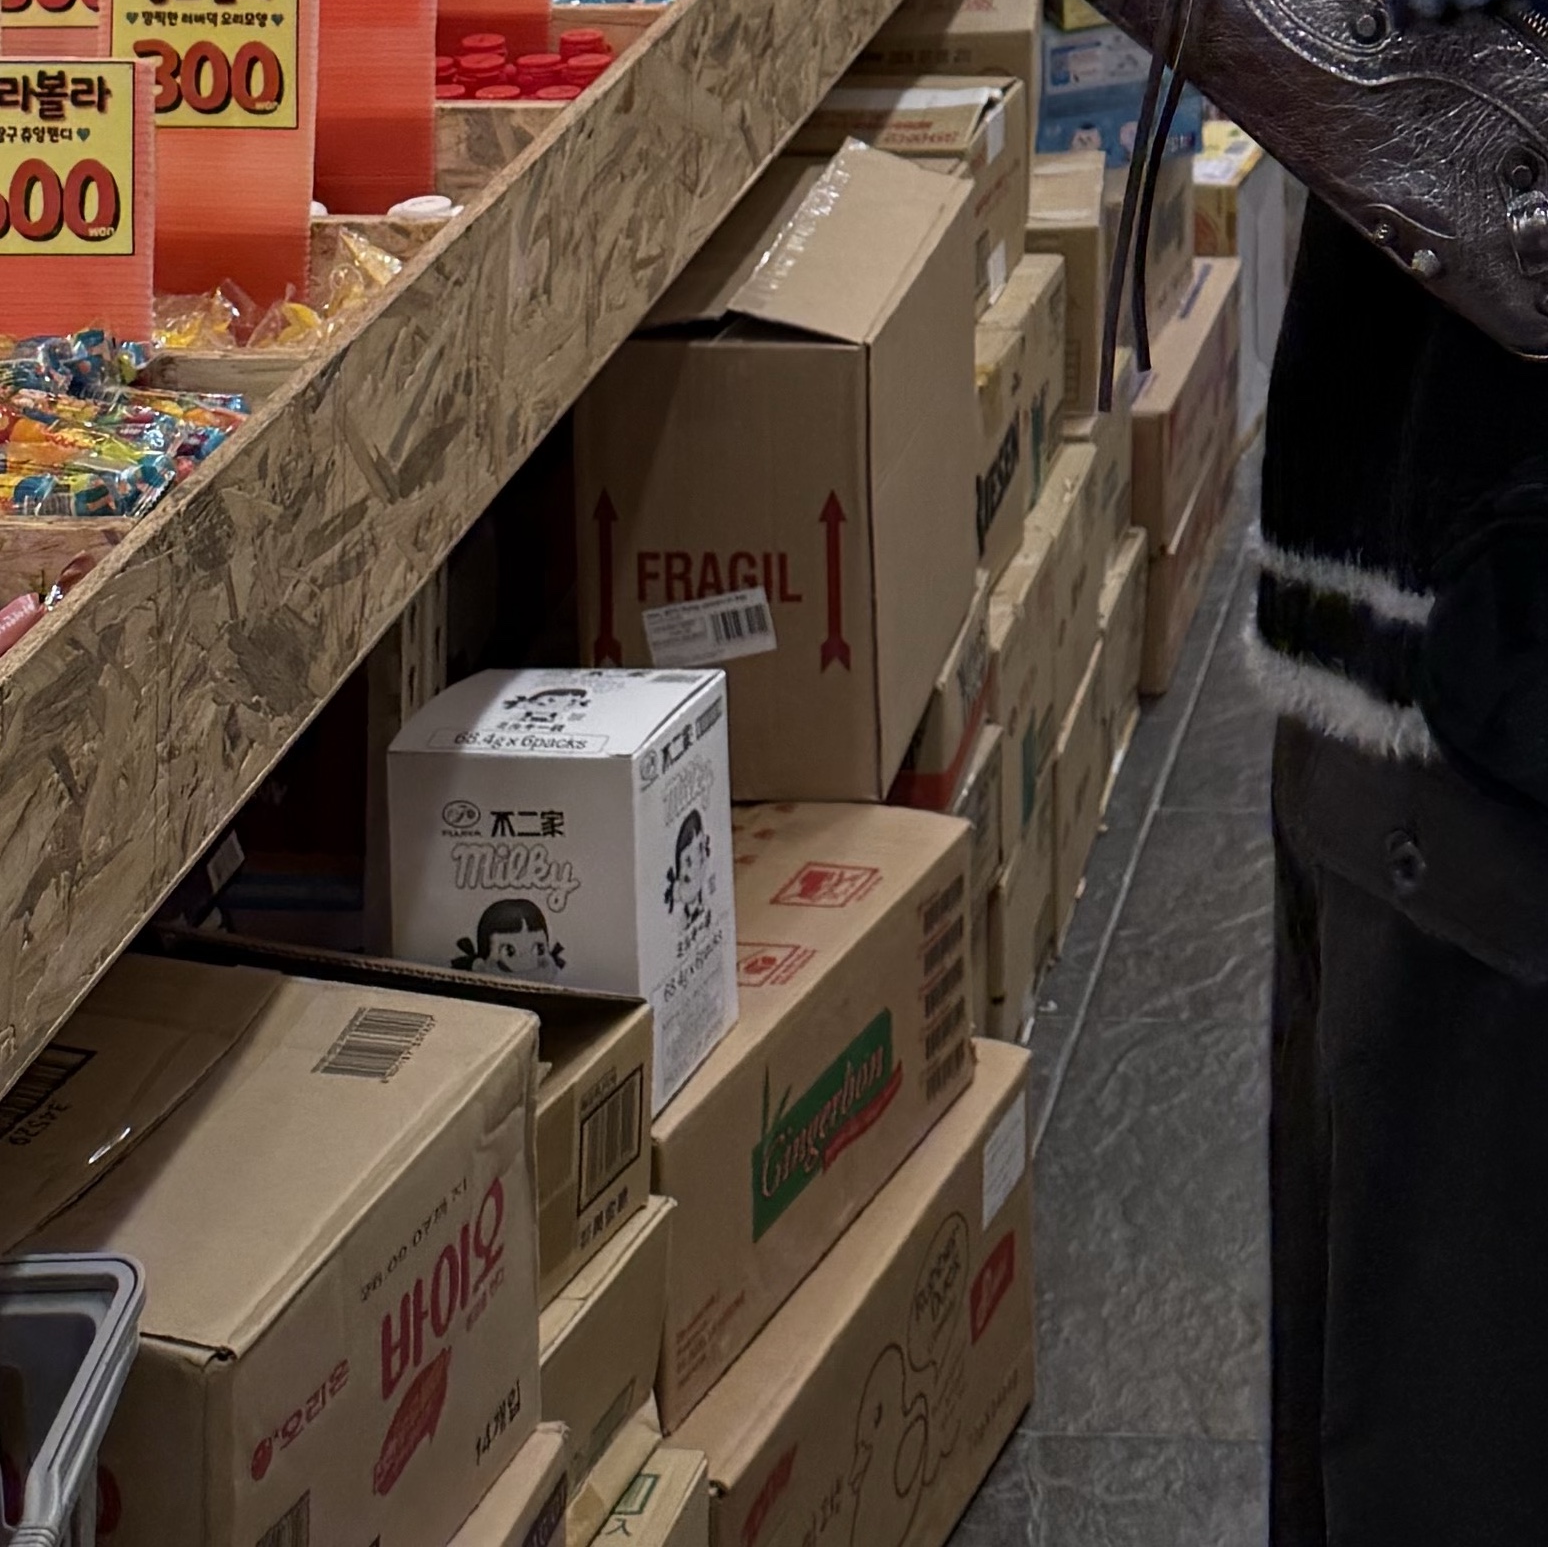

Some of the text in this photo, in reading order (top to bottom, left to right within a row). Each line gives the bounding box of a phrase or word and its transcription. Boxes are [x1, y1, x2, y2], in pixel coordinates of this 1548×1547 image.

[132, 38, 284, 114] 300
[636, 552, 804, 603] FRAGIL
[489, 810, 567, 838] 不二家
[451, 842, 582, 913] Milky
